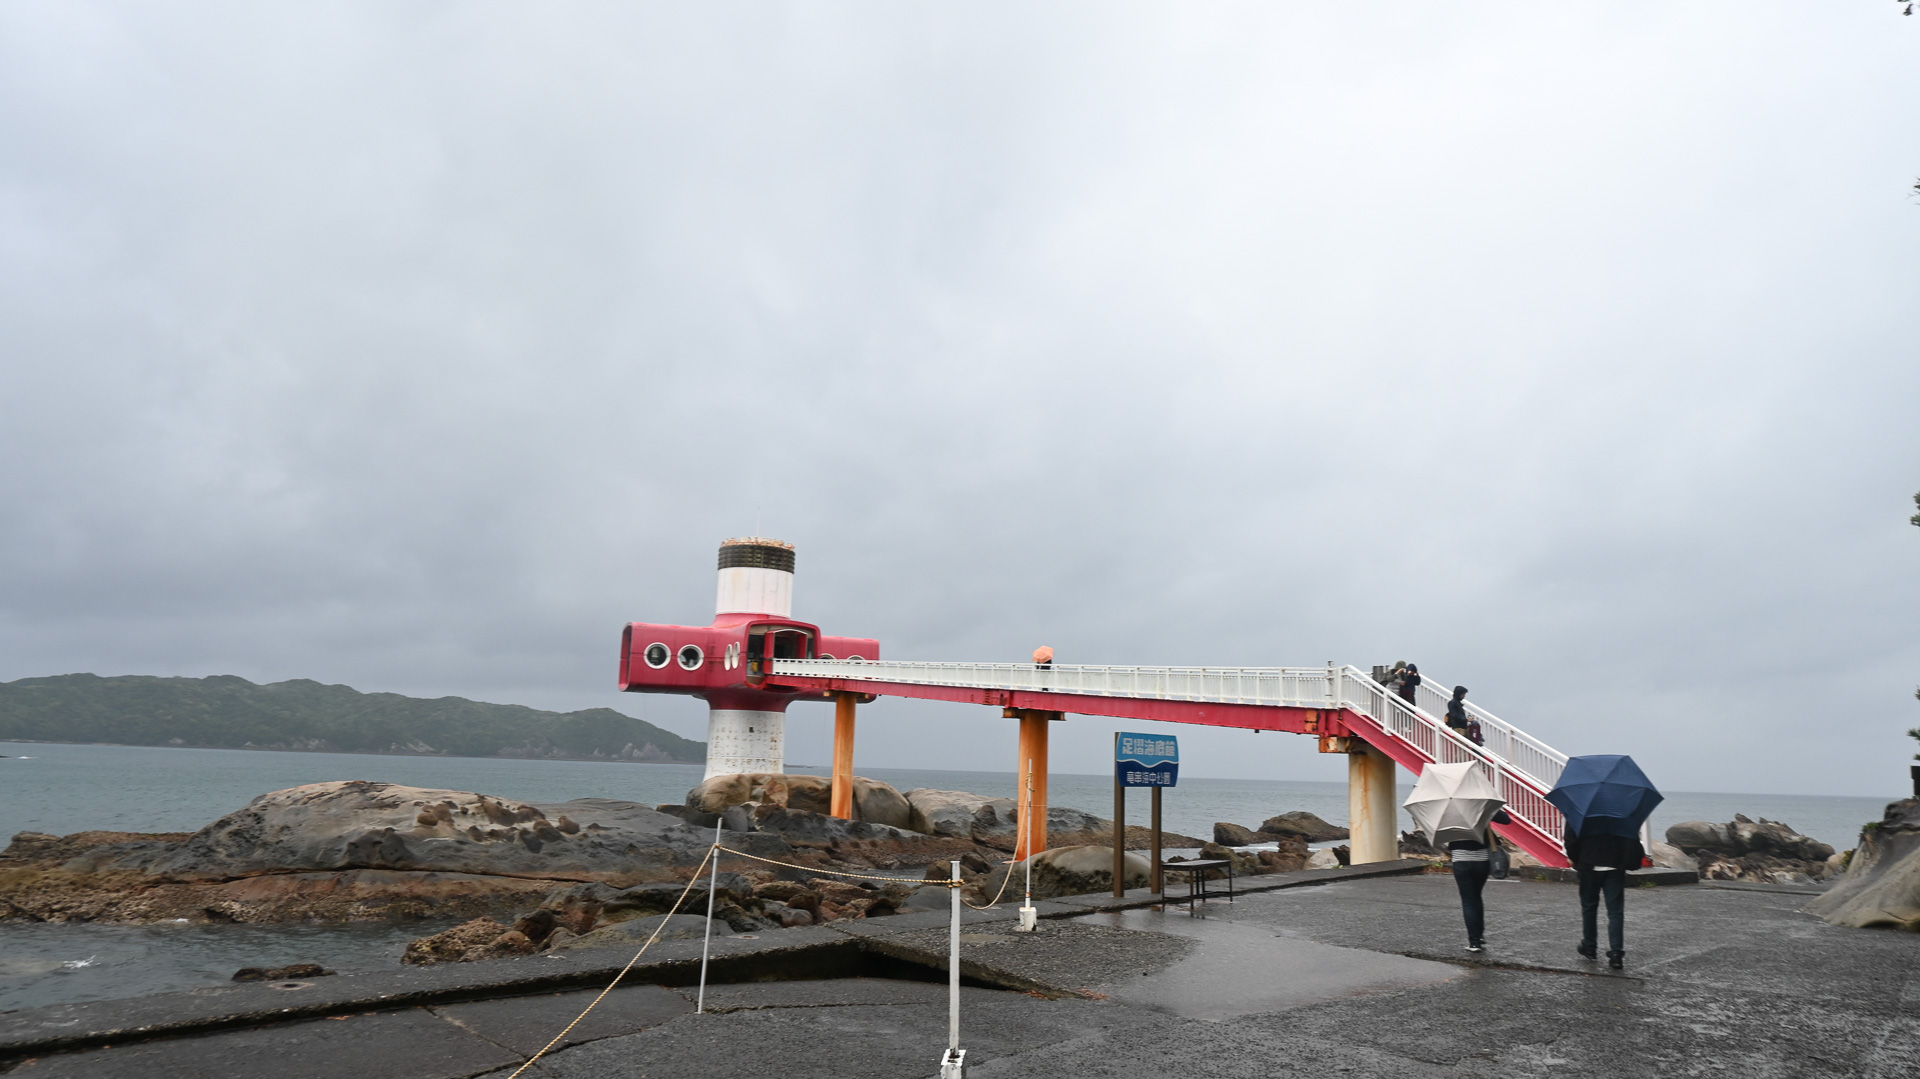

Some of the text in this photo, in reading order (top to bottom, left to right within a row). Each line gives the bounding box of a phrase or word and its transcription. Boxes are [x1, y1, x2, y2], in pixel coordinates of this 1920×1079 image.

[1122, 738, 1175, 756] 足摺海底館
